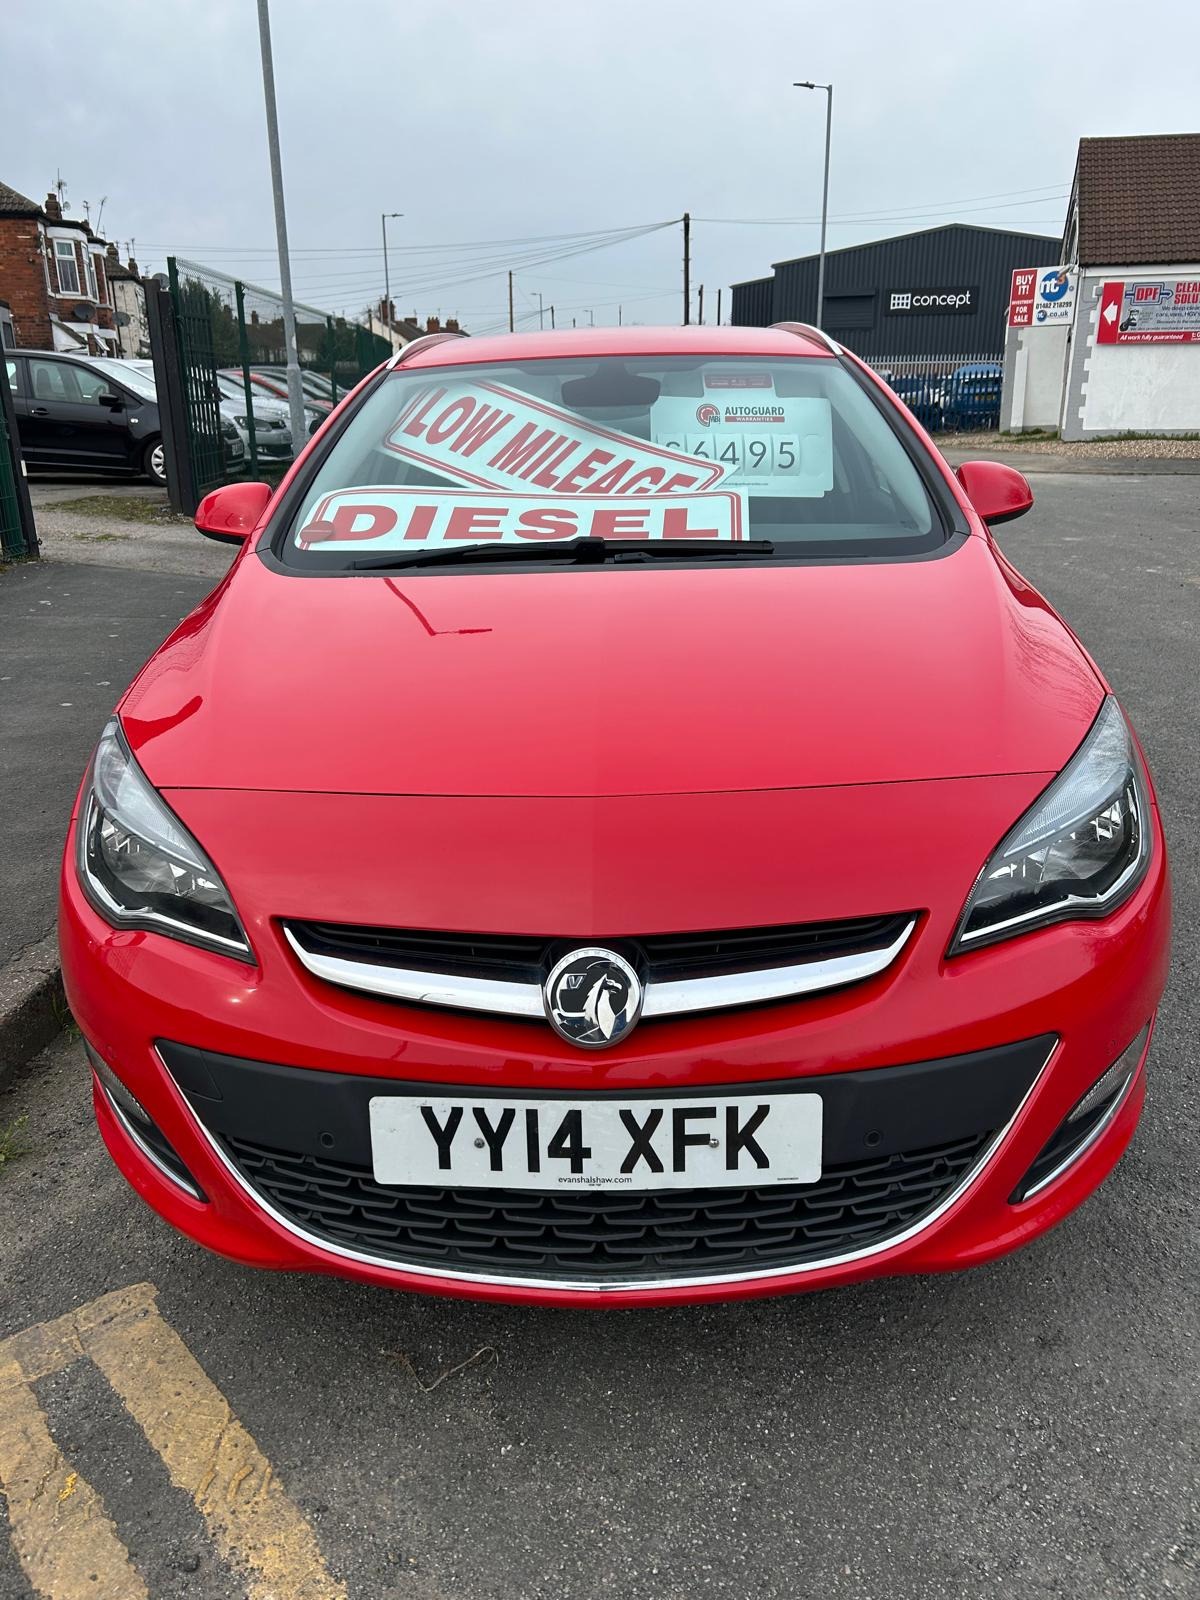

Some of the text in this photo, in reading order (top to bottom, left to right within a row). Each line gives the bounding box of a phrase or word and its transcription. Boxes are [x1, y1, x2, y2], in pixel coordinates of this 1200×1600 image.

[1016, 274, 1034, 285] BUY
[1018, 285, 1029, 295] IT!
[1136, 287, 1159, 301] DPF
[912, 290, 971, 309] concept
[1174, 293, 1200, 304] SOLU
[1016, 306, 1028, 314] FOR
[1014, 315, 1028, 323] SALE
[1153, 333, 1184, 341] guaranteed
[725, 407, 785, 416] AUTOGUARD
[403, 388, 516, 458] LOW
[328, 505, 719, 541] DIESEL
[420, 1104, 771, 1173] YY14 XFK
[558, 1175, 633, 1184] evanshalshaw.com
